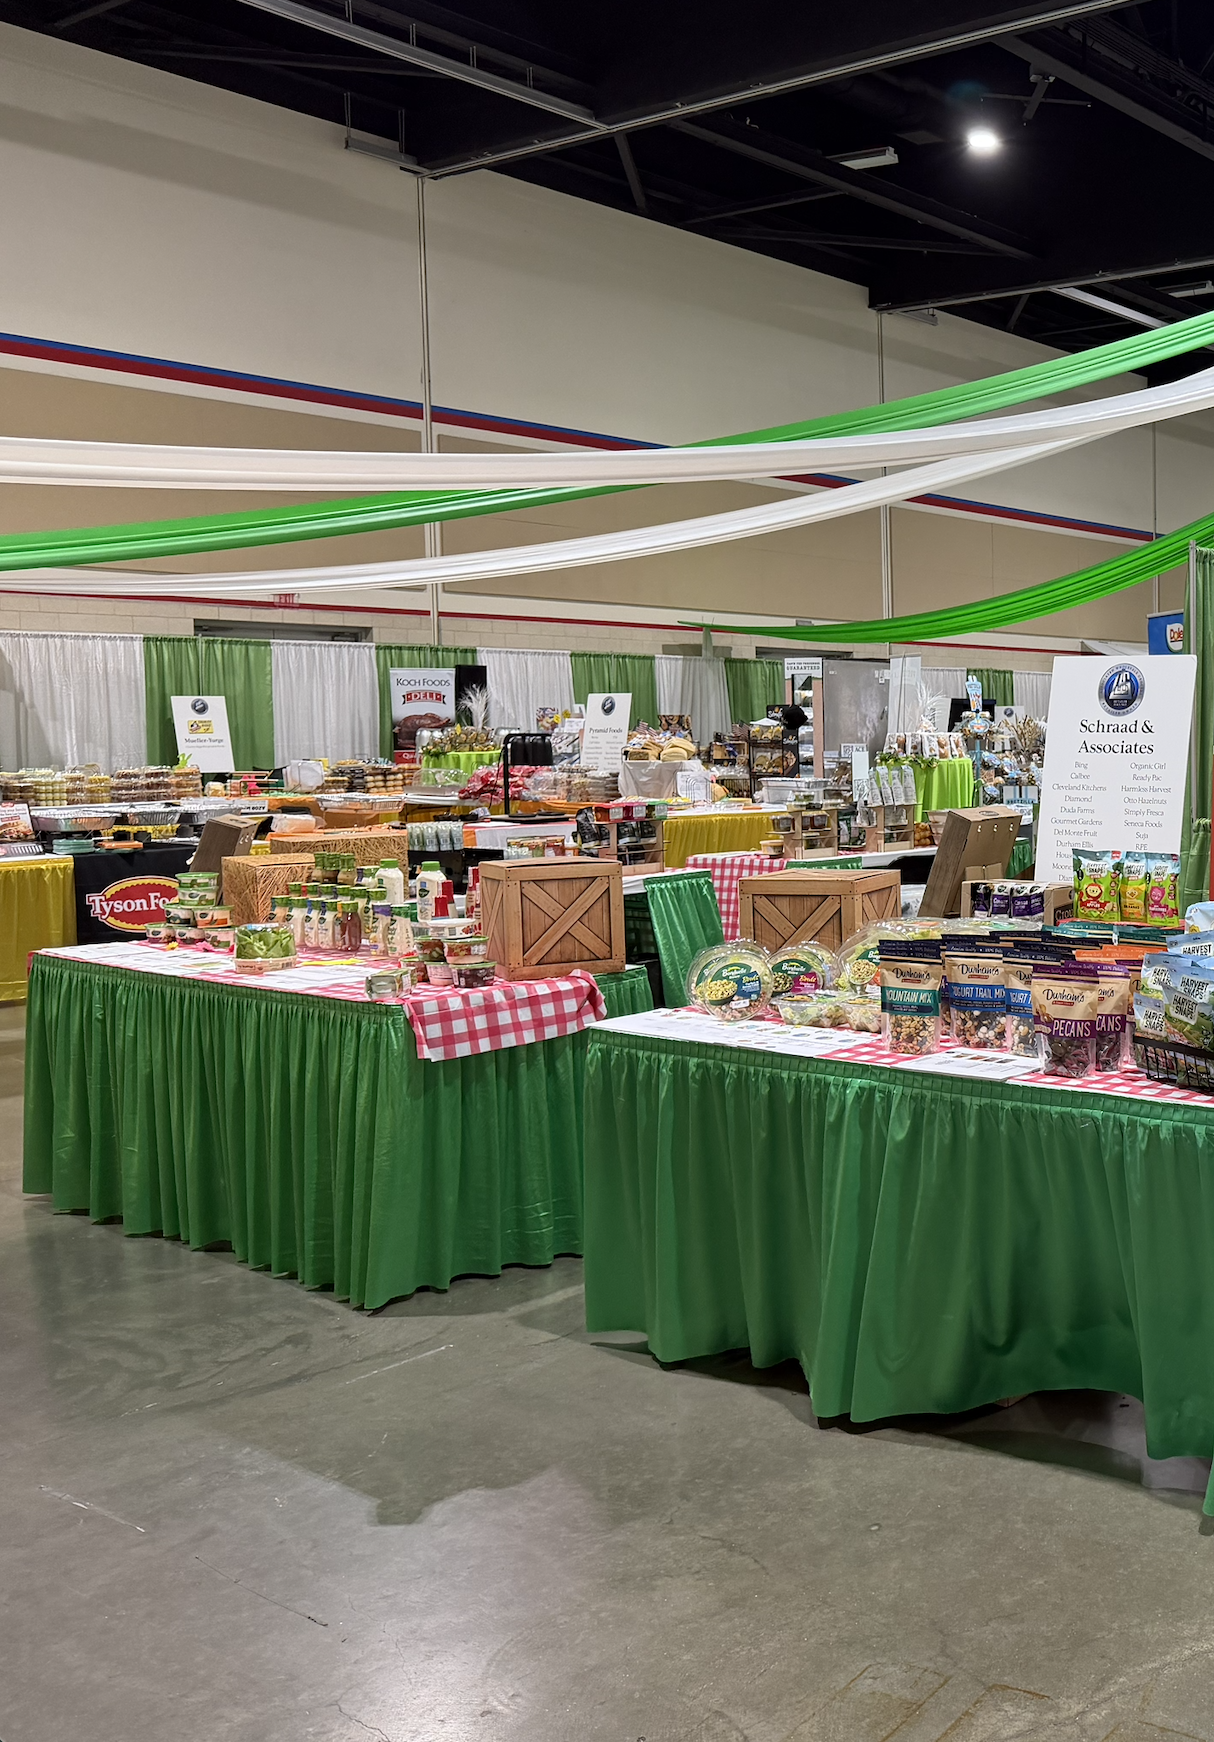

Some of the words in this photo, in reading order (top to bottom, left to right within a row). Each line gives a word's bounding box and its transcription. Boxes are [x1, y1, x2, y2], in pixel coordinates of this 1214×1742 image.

[396, 678, 420, 686] KOCH
[422, 678, 450, 686] FOODS
[412, 692, 436, 700] DELI
[1080, 719, 1138, 734] Schraad
[1141, 720, 1154, 734] &
[1078, 740, 1154, 754] Associates
[1074, 762, 1088, 770] Bing
[1130, 762, 1153, 772] Organic
[1154, 762, 1166, 770] Girl
[1070, 772, 1090, 780] Calbee
[1132, 774, 1151, 783] Ready
[1152, 774, 1162, 782] Pac
[1052, 784, 1081, 792] Cleveland
[1082, 784, 1107, 792] Kitchens
[1124, 796, 1137, 804] Otto
[1138, 797, 1167, 805] Hazelnuts
[1060, 806, 1076, 814] Duda
[1124, 808, 1145, 817] Simply
[1078, 818, 1102, 826] Gardens
[1145, 820, 1163, 828] Foods
[1084, 829, 1098, 837] Fruit
[1056, 840, 1081, 848] Durham
[89, 894, 149, 919] Tyson
[1182, 944, 1211, 956] HARVEST
[892, 968, 931, 980] Durham's
[958, 964, 999, 976] Durham's
[1180, 976, 1209, 991] HARVEST
[919, 992, 932, 1004] MIX
[975, 988, 992, 998] TRAIL
[1042, 988, 1084, 1002] Durham's
[1099, 987, 1115, 998] am's
[1173, 994, 1198, 1012] HARVEST
[1143, 1009, 1165, 1021] HARVES
[1175, 1004, 1193, 1019] SNAPS
[1052, 1020, 1091, 1038] PECANS
[1096, 1015, 1121, 1032] CANS
[1144, 1020, 1164, 1032] SNAPS
